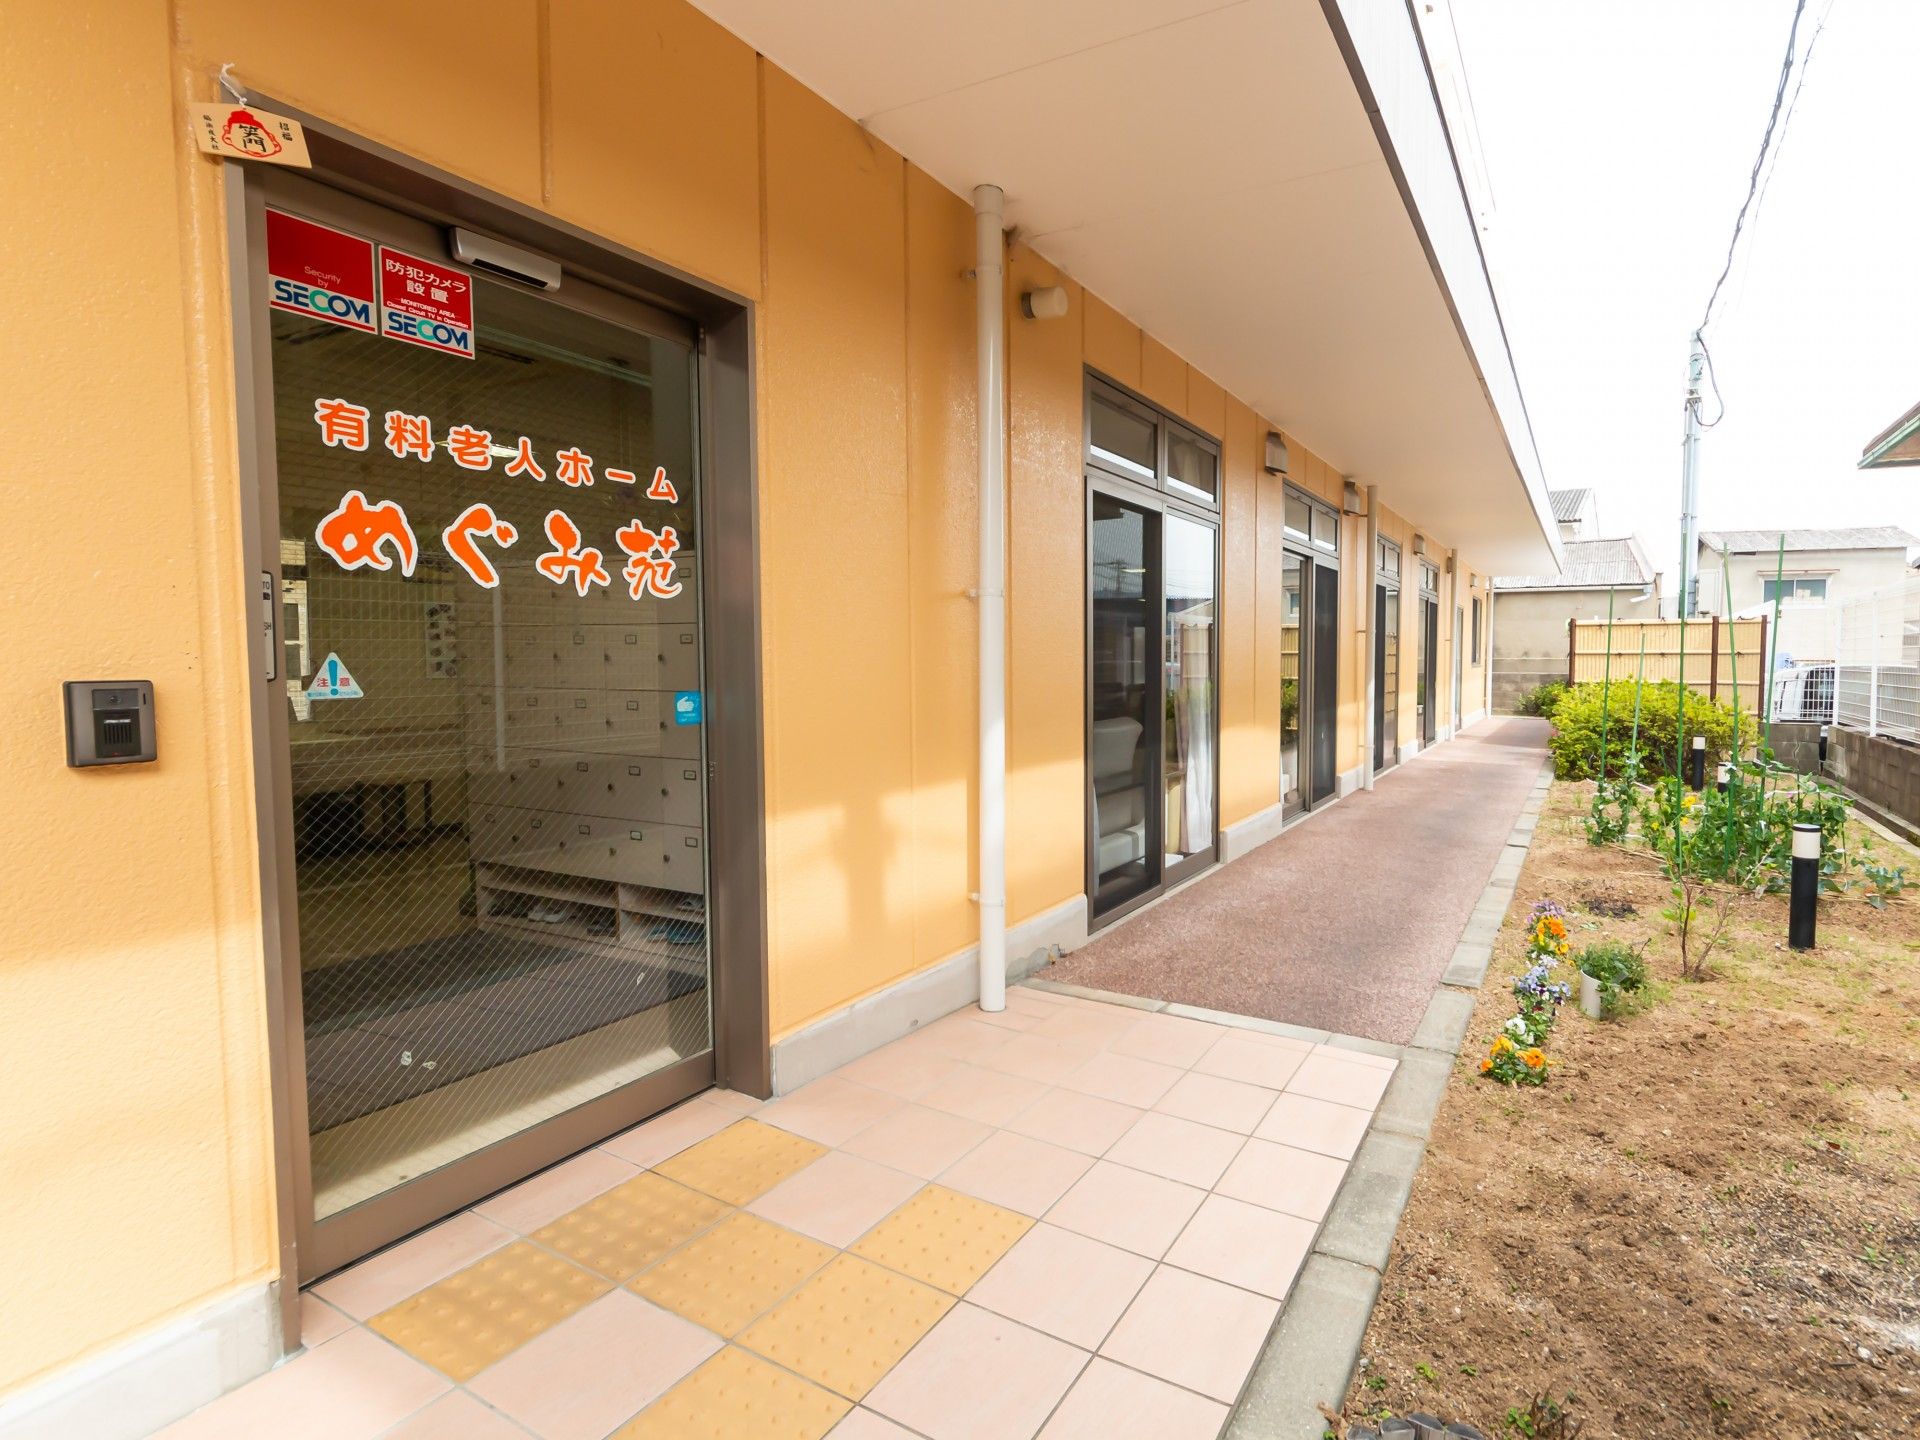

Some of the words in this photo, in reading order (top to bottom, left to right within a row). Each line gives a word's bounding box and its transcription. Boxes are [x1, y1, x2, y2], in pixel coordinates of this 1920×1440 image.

[304, 265, 341, 285] Security
[317, 278, 329, 289] by
[385, 258, 467, 293] 防犯カメラ
[406, 279, 449, 304] 設置
[274, 279, 370, 324] SECOM
[400, 297, 438, 314] MONITORED
[438, 309, 456, 319] AREA
[387, 311, 469, 350] SECOM
[314, 397, 680, 504] 有料老人ホーム
[315, 489, 683, 601] めぐみ苑
